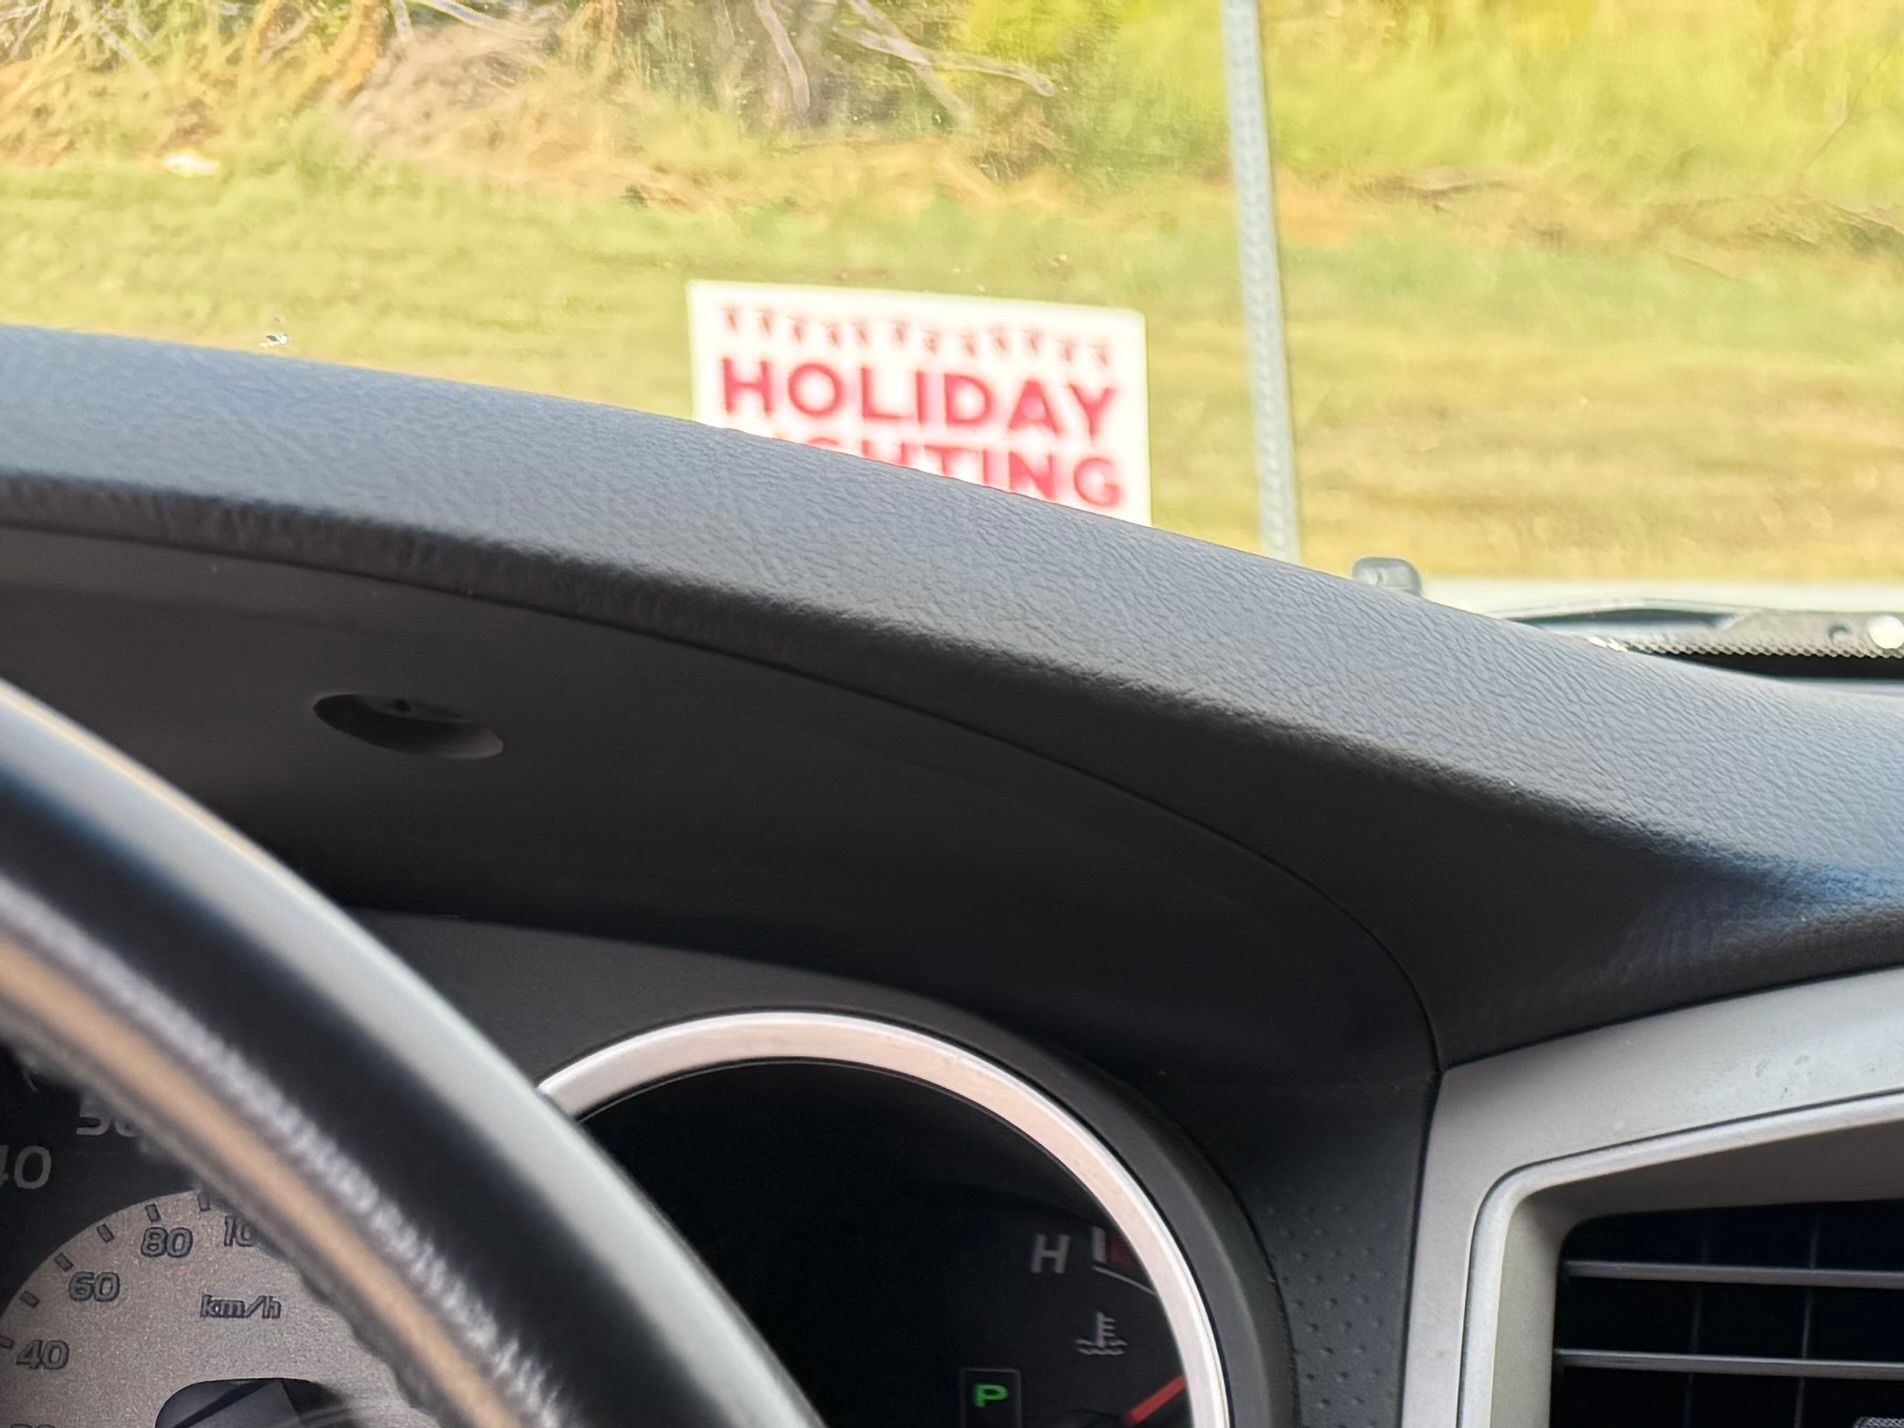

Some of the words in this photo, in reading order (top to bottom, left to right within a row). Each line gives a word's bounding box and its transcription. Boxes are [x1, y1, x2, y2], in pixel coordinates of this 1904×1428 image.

[722, 356, 1117, 441] HOLIDAY
[142, 1227, 192, 1258] 80
[1031, 1234, 1071, 1274] H
[69, 1273, 119, 1303] 60
[200, 1297, 281, 1320] km/h
[16, 1341, 68, 1370] 40
[974, 1383, 1008, 1407] P
